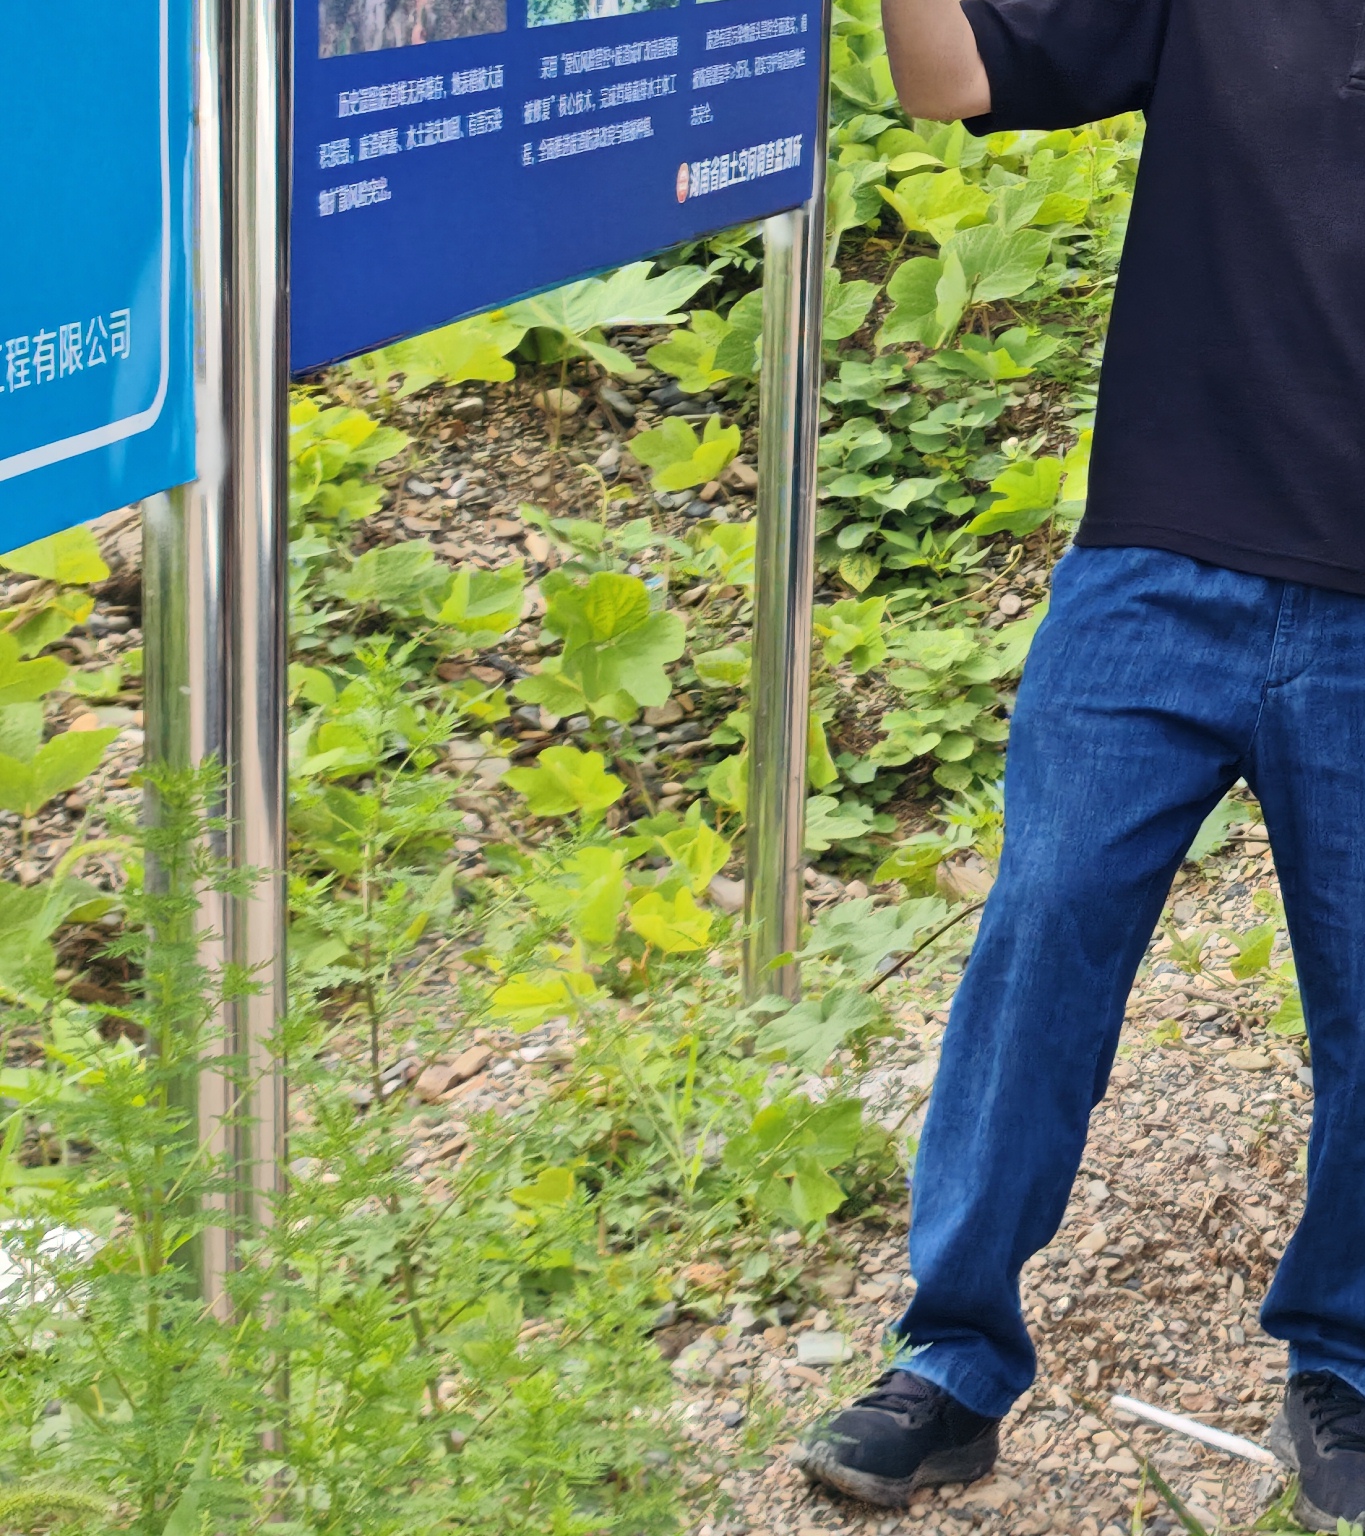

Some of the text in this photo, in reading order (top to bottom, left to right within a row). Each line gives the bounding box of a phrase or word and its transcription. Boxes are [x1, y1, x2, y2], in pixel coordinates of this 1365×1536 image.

[0, 308, 130, 393] 程有限公司
